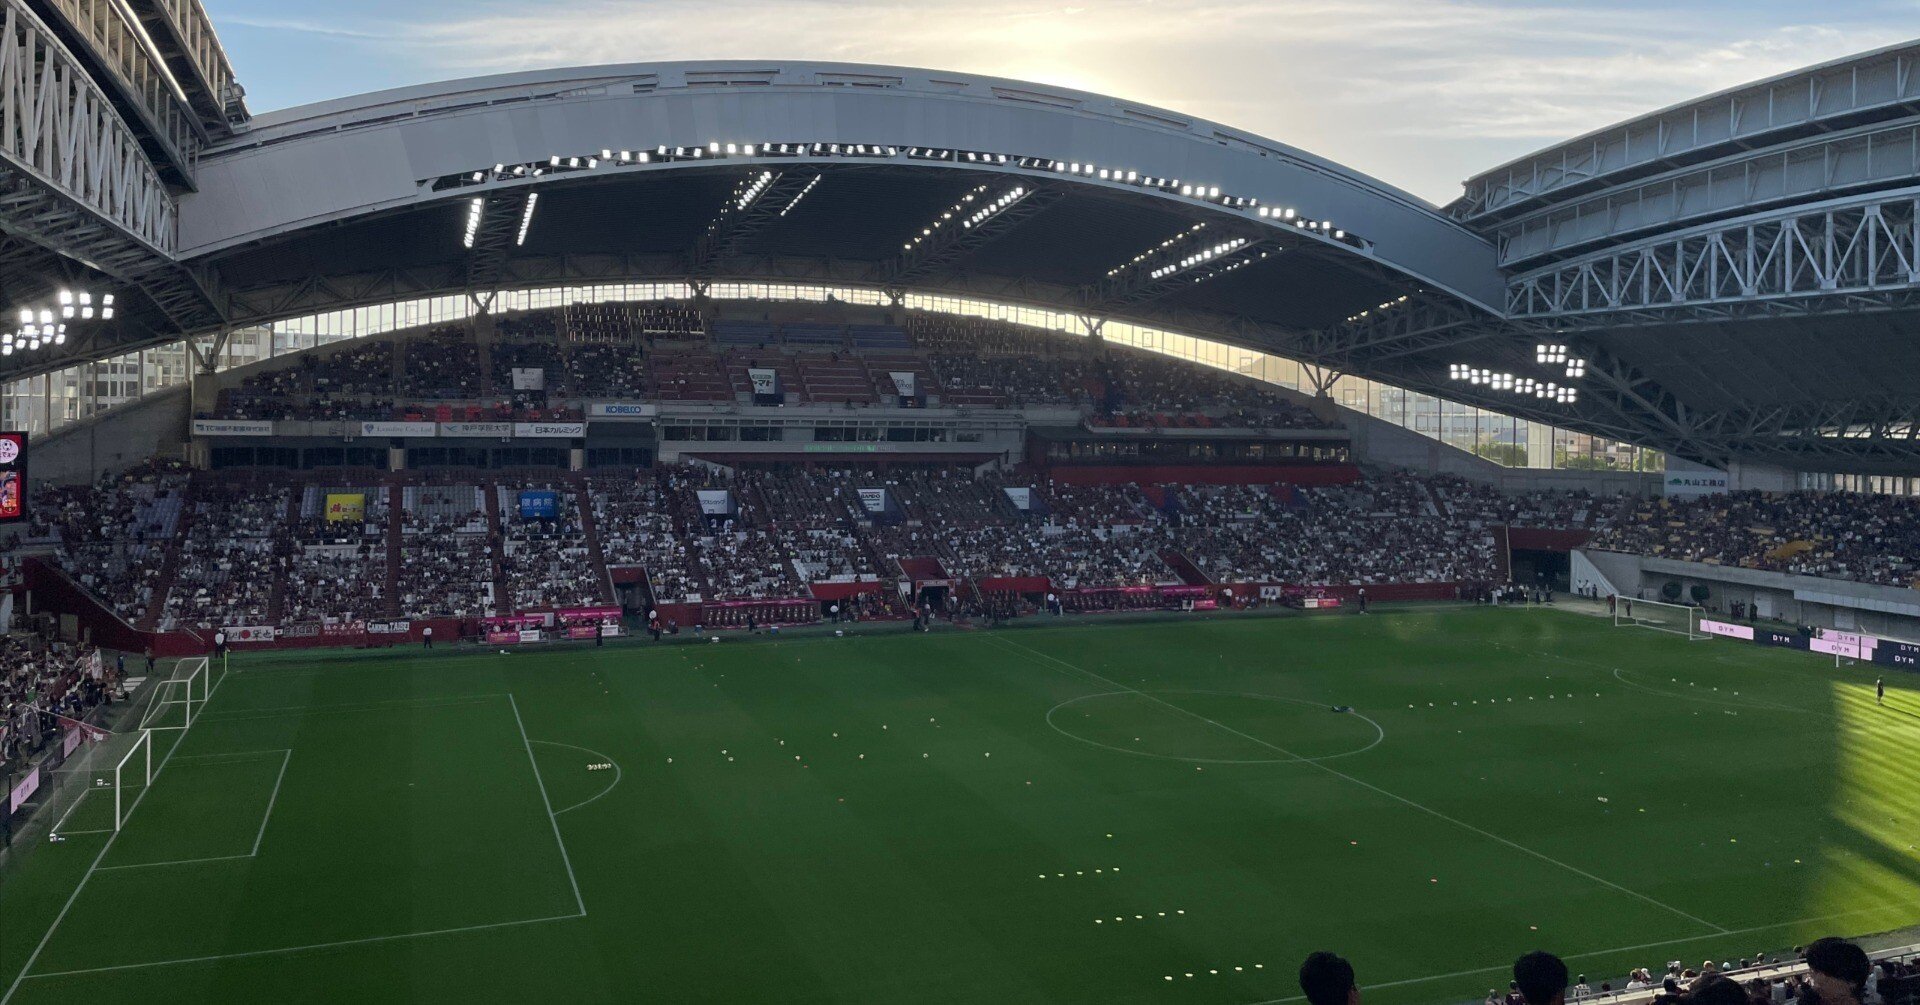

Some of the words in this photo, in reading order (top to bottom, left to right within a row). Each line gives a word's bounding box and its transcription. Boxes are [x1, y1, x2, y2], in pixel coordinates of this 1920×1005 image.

[605, 405, 642, 414] KOBELCO
[535, 426, 582, 434] 日本カルミック
[1684, 479, 1725, 487] 丸山工務店
[1718, 625, 1734, 633] DYM
[1772, 634, 1790, 643] DYM
[1831, 645, 1850, 653] DYM
[1900, 644, 1919, 653] DYM
[1894, 655, 1914, 664] DYM
